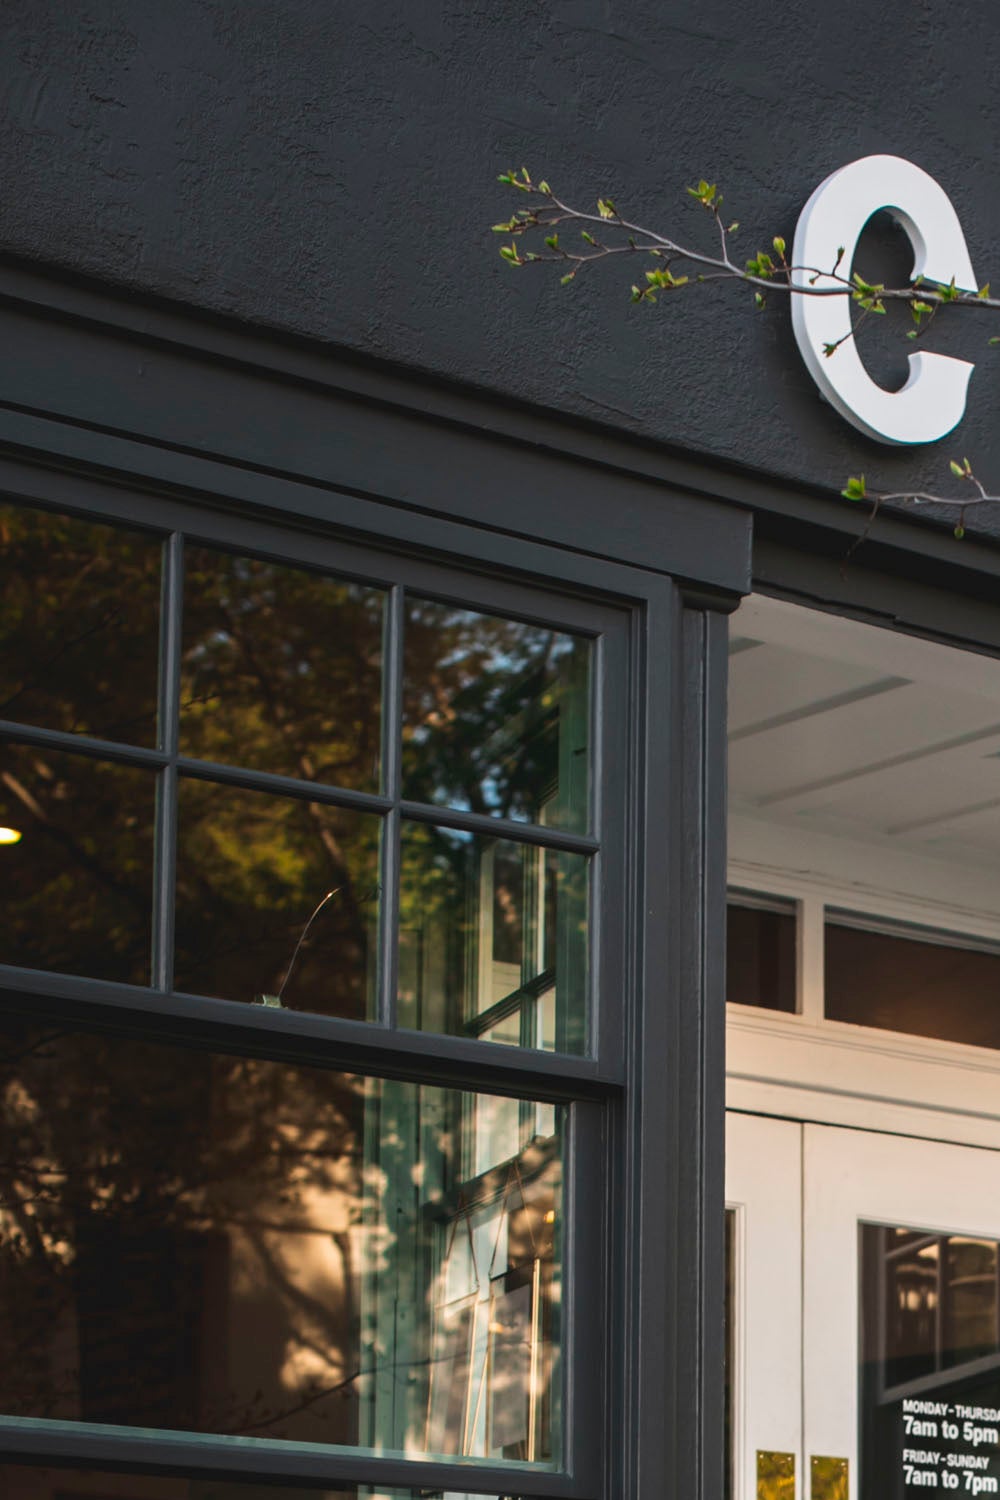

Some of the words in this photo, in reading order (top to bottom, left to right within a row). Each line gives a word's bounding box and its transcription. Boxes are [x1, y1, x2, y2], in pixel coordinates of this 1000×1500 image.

[903, 1415, 938, 1438] 7am
[941, 1420, 959, 1440] to
[963, 1422, 999, 1447] 5pm
[903, 1465, 938, 1487] 7am
[941, 1469, 959, 1489] to
[963, 1471, 998, 1496] 7pm
